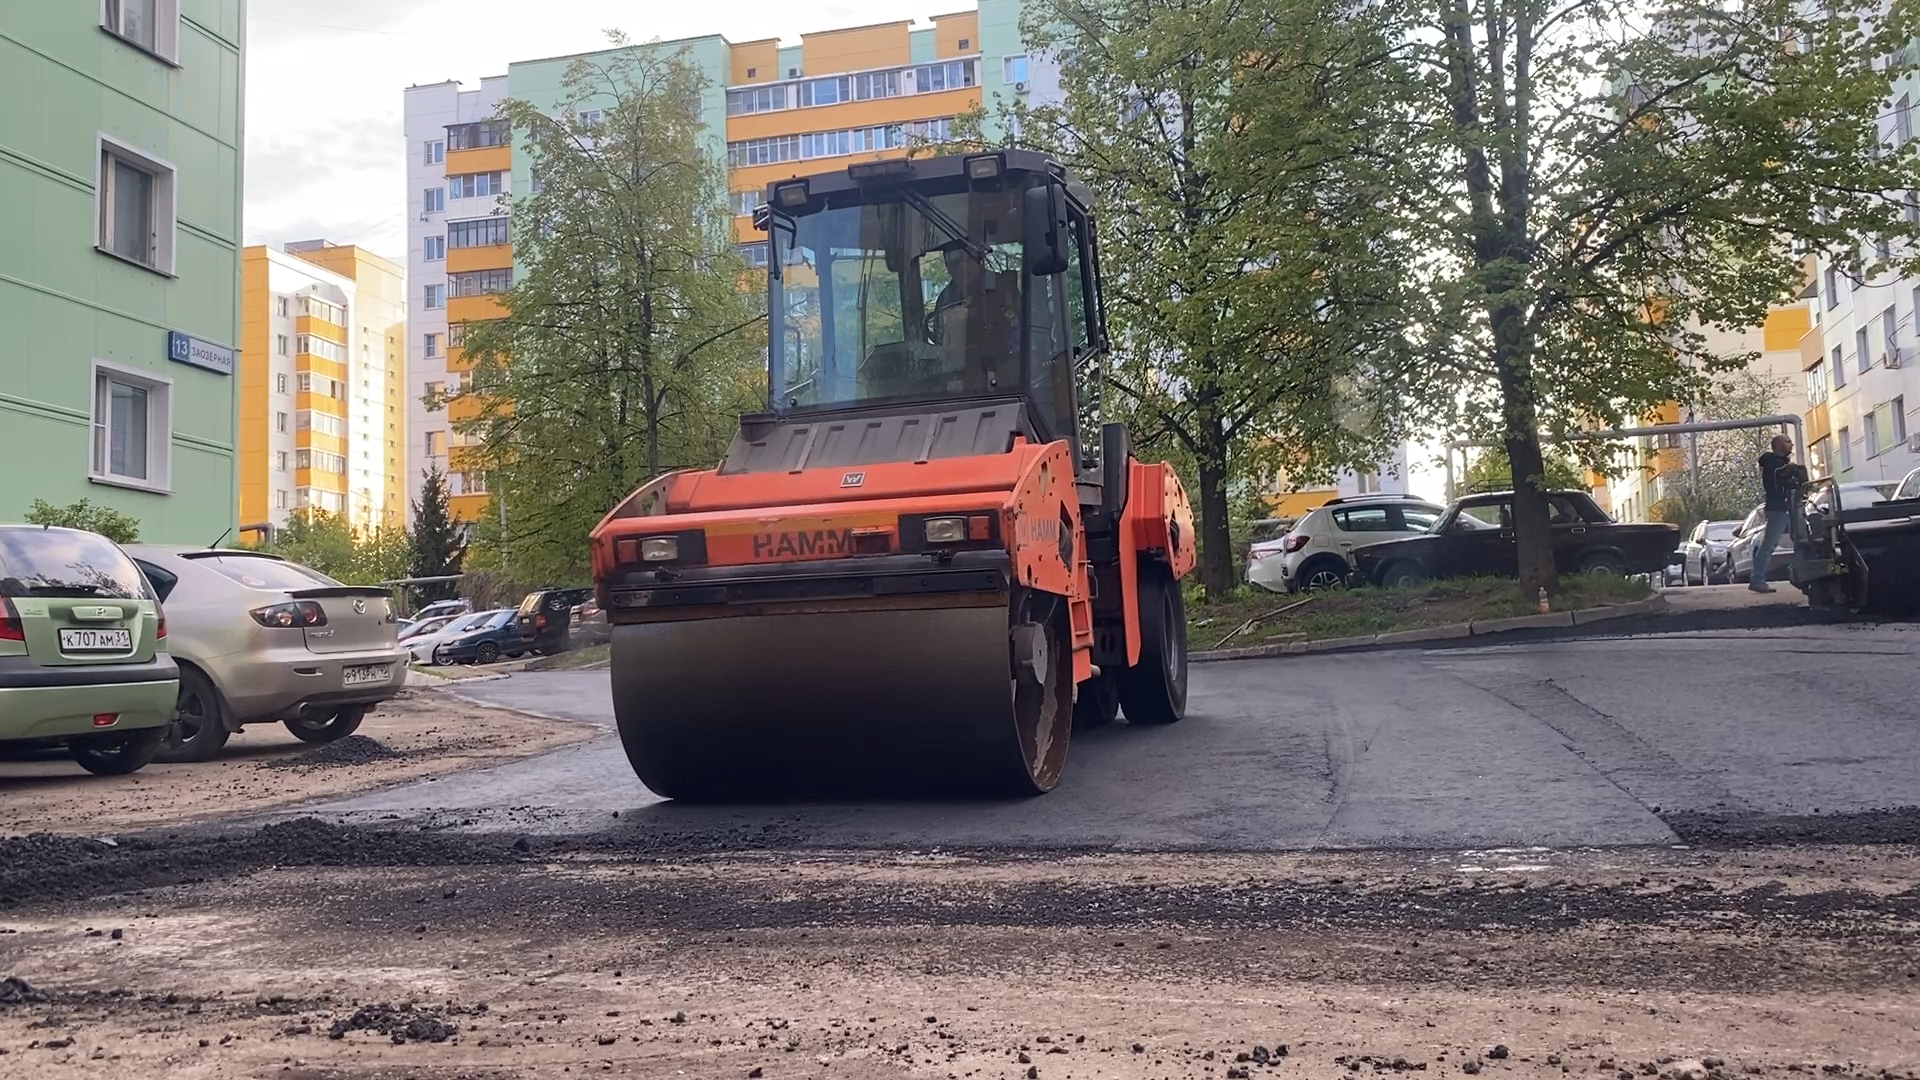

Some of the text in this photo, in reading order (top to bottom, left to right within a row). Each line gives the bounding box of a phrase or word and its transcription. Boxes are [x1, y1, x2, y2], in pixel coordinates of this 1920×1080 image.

[175, 340, 231, 367] 13 ЗАОЗЕРНАЯ
[1031, 518, 1056, 541] HAMM
